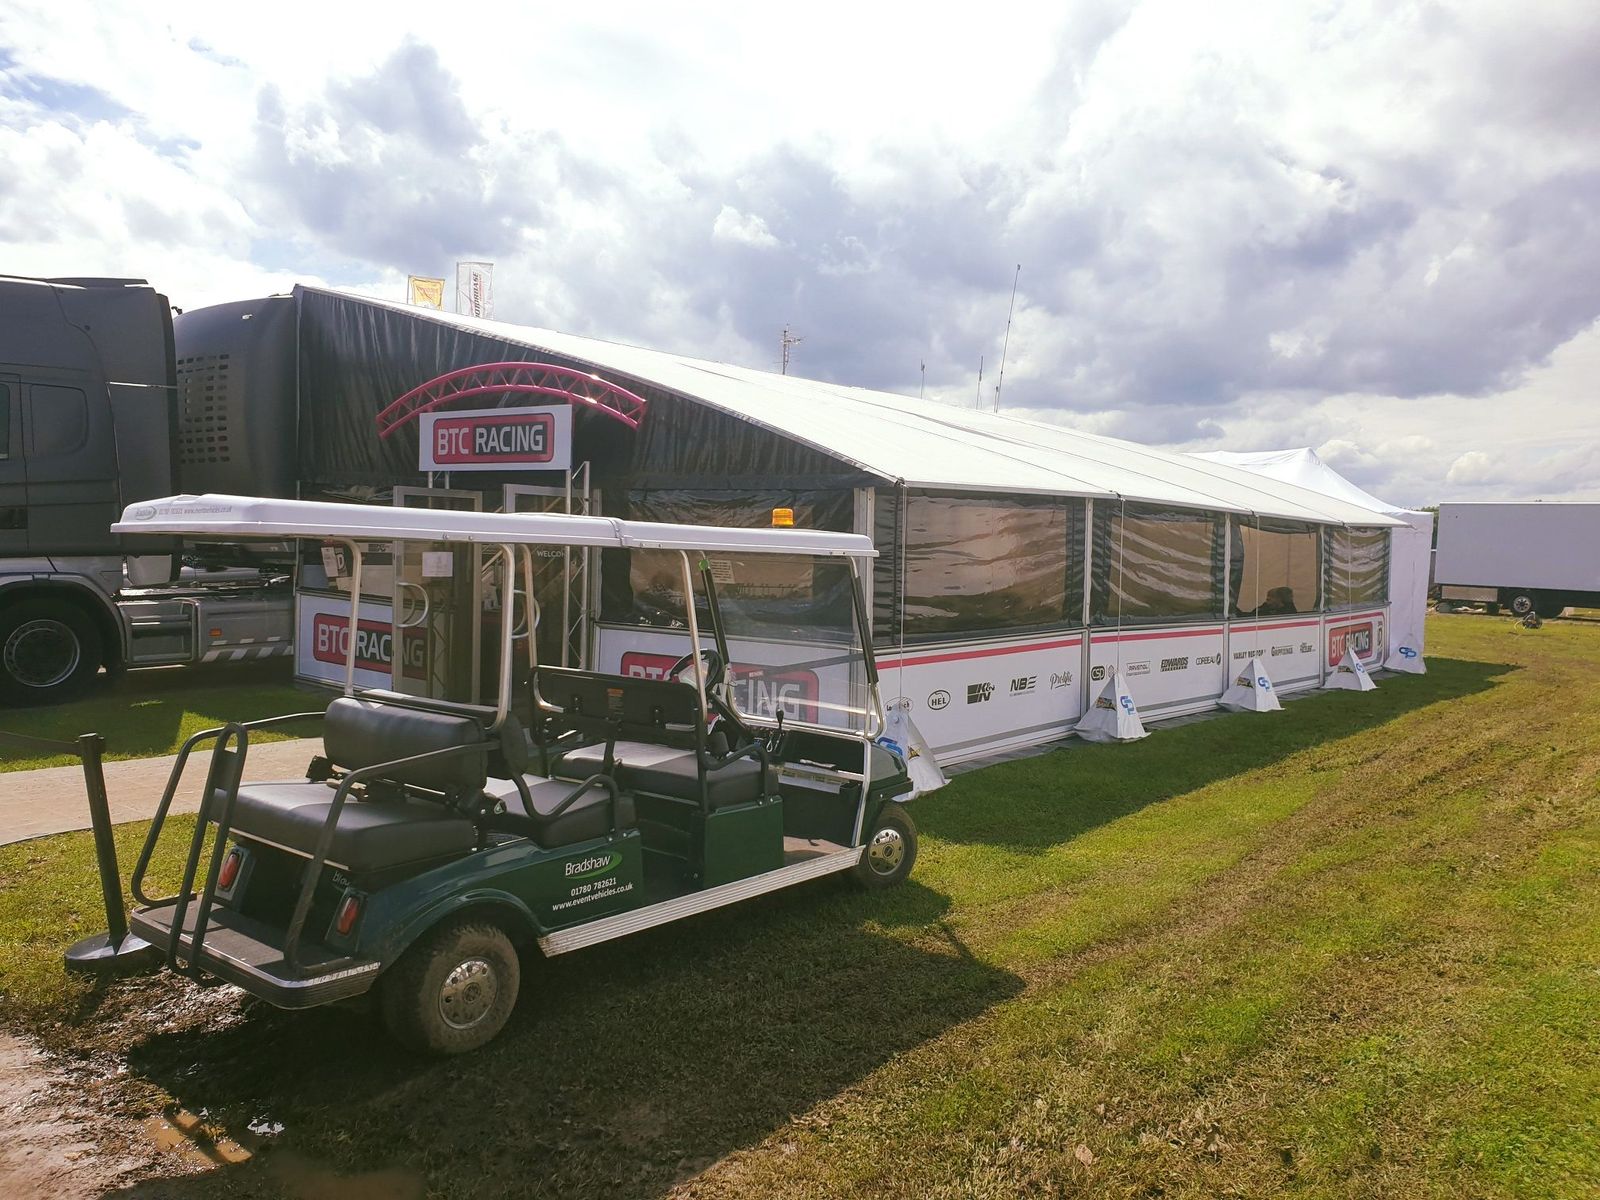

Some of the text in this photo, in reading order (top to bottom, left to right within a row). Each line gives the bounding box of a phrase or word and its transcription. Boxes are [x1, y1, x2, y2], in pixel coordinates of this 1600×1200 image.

[437, 424, 544, 455] BTC RACING
[537, 550, 564, 558] WELCO
[318, 623, 425, 668] BTC RACNG
[1331, 632, 1345, 658] BTC
[1345, 629, 1370, 652] RACING
[1161, 656, 1189, 668] EDWARDS
[931, 697, 947, 706] HEL
[565, 855, 611, 876] Bradshaw
[552, 882, 633, 911] www.eventvehicles.co.uk
[571, 877, 617, 896] 01780 782621
